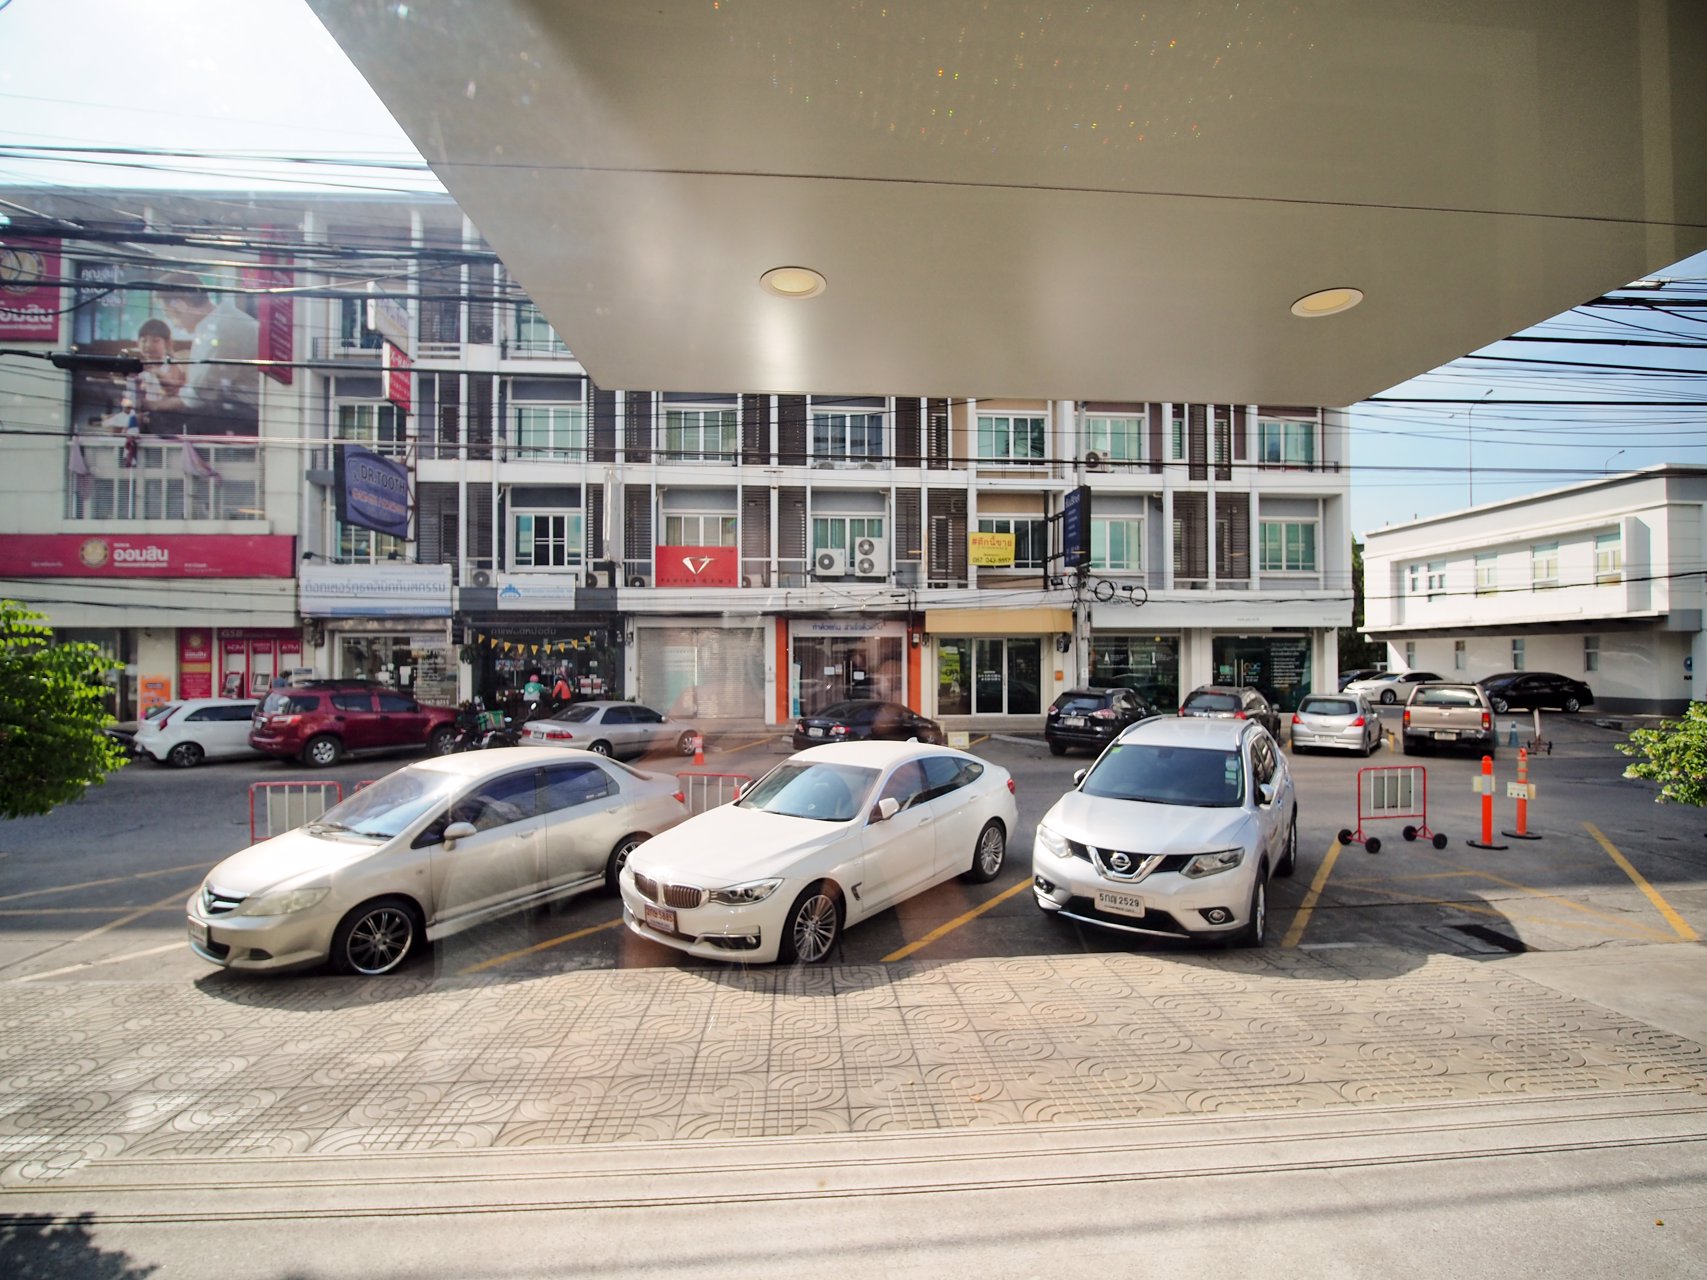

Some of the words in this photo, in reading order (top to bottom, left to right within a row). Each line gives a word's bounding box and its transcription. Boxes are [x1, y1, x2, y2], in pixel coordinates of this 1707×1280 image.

[361, 464, 405, 491] DR.TOOTH
[113, 545, 169, 561] ออมสิน
[1118, 896, 1140, 907] 2529
